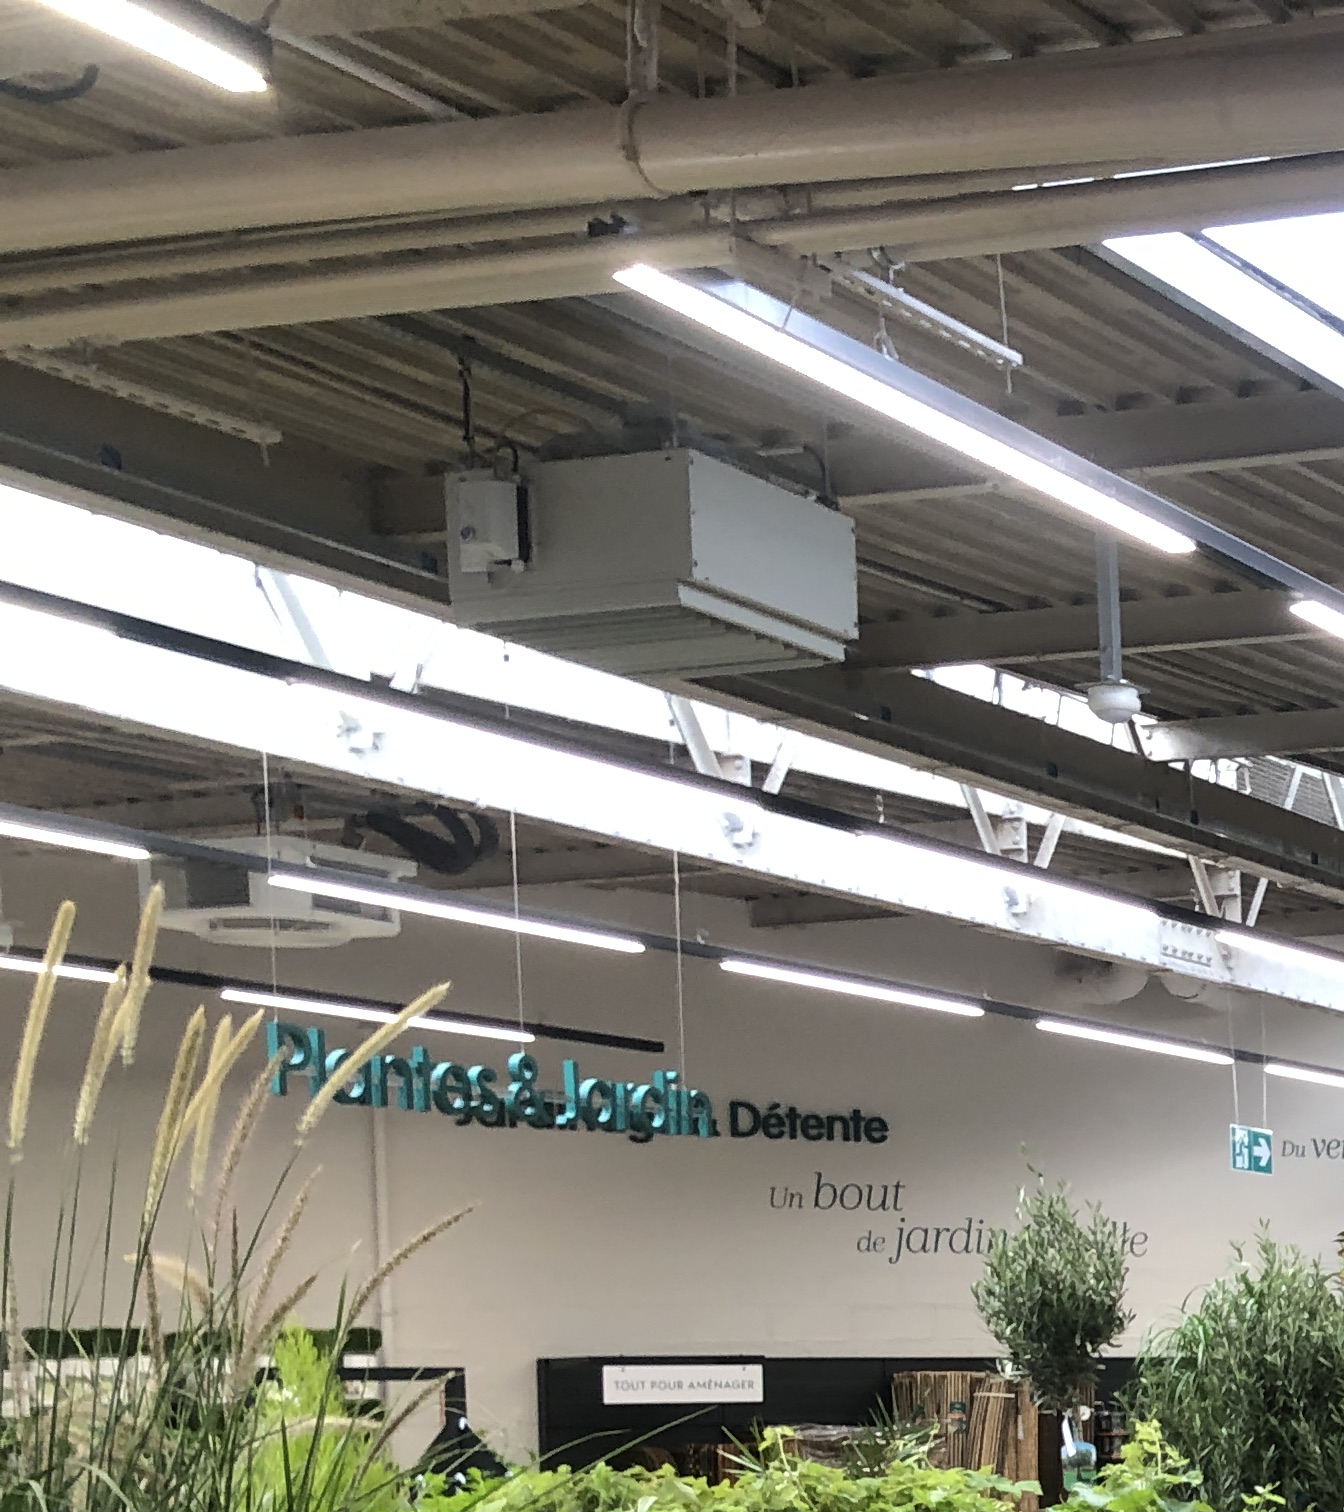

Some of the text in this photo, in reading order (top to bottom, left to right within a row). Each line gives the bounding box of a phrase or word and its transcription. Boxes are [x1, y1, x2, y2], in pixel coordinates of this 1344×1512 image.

[266, 1020, 713, 1138] Plantes & Jardin
[729, 1101, 889, 1144] Détente
[1281, 1140, 1305, 1158] Du
[770, 1171, 905, 1211] Un bout
[857, 1230, 885, 1253] de
[888, 1217, 1007, 1264] jardin
[614, 1378, 755, 1391] TOUT POUR AMÉNAGER
